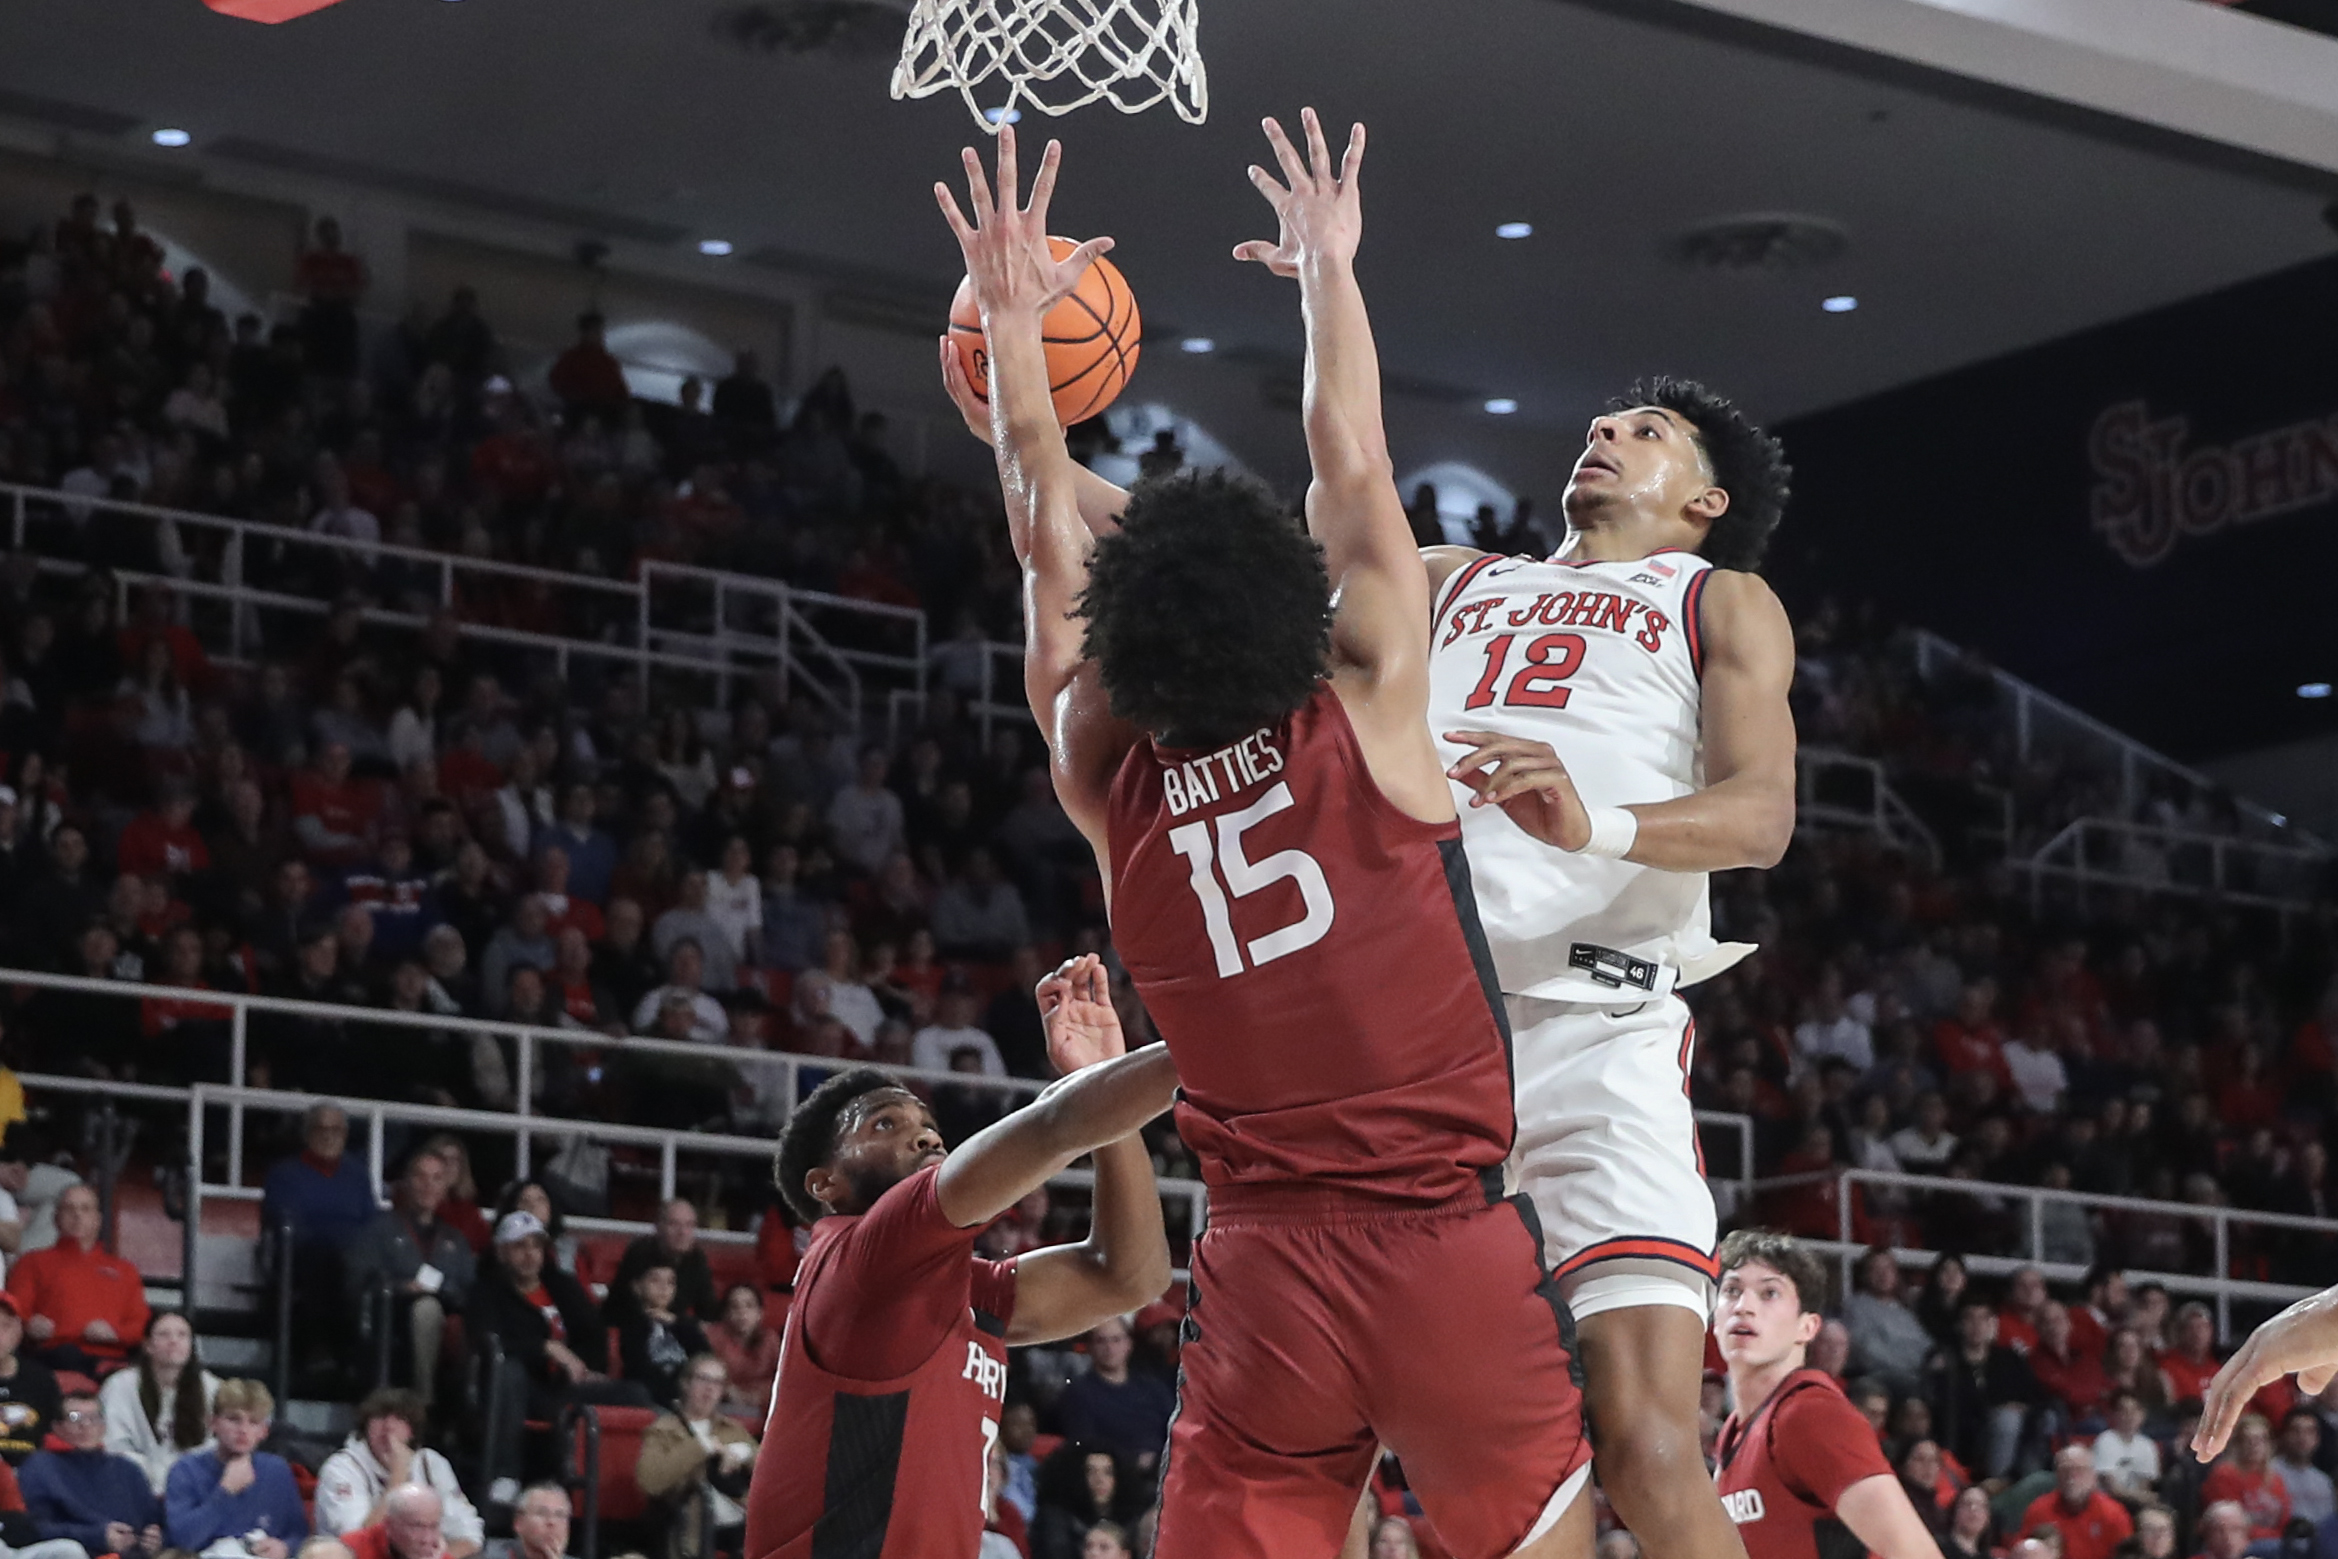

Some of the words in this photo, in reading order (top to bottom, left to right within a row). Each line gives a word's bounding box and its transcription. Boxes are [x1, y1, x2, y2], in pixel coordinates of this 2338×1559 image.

[1508, 591, 1669, 653] JOHN'S
[1465, 632, 1587, 711] 12
[1163, 727, 1284, 816] BATTIES
[1167, 780, 1335, 979] 15
[1629, 965, 1645, 980] 46
